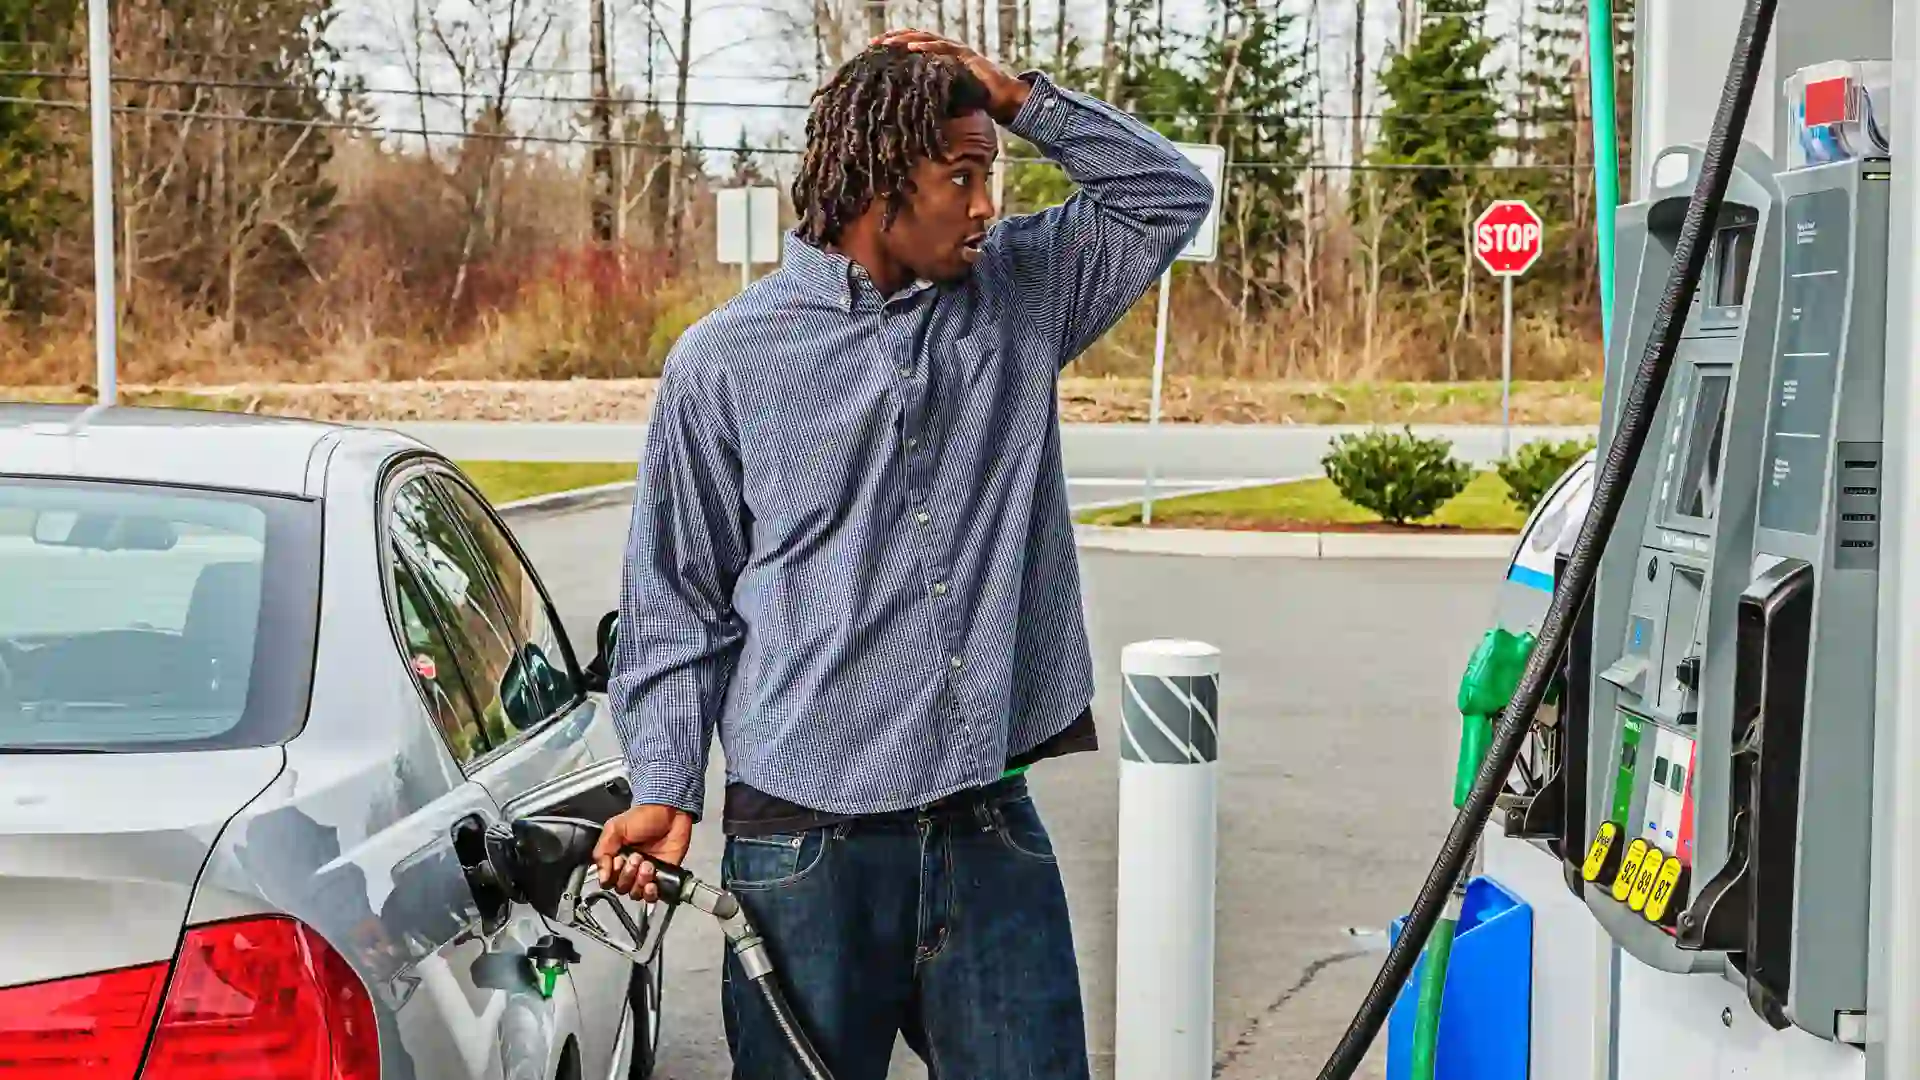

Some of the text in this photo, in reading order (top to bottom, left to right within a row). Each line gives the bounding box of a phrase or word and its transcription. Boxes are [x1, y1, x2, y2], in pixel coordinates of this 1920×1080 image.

[1479, 223, 1538, 253] STOP
[1621, 860, 1637, 885] 92
[1637, 870, 1652, 894] 89
[1654, 880, 1671, 904] 87
